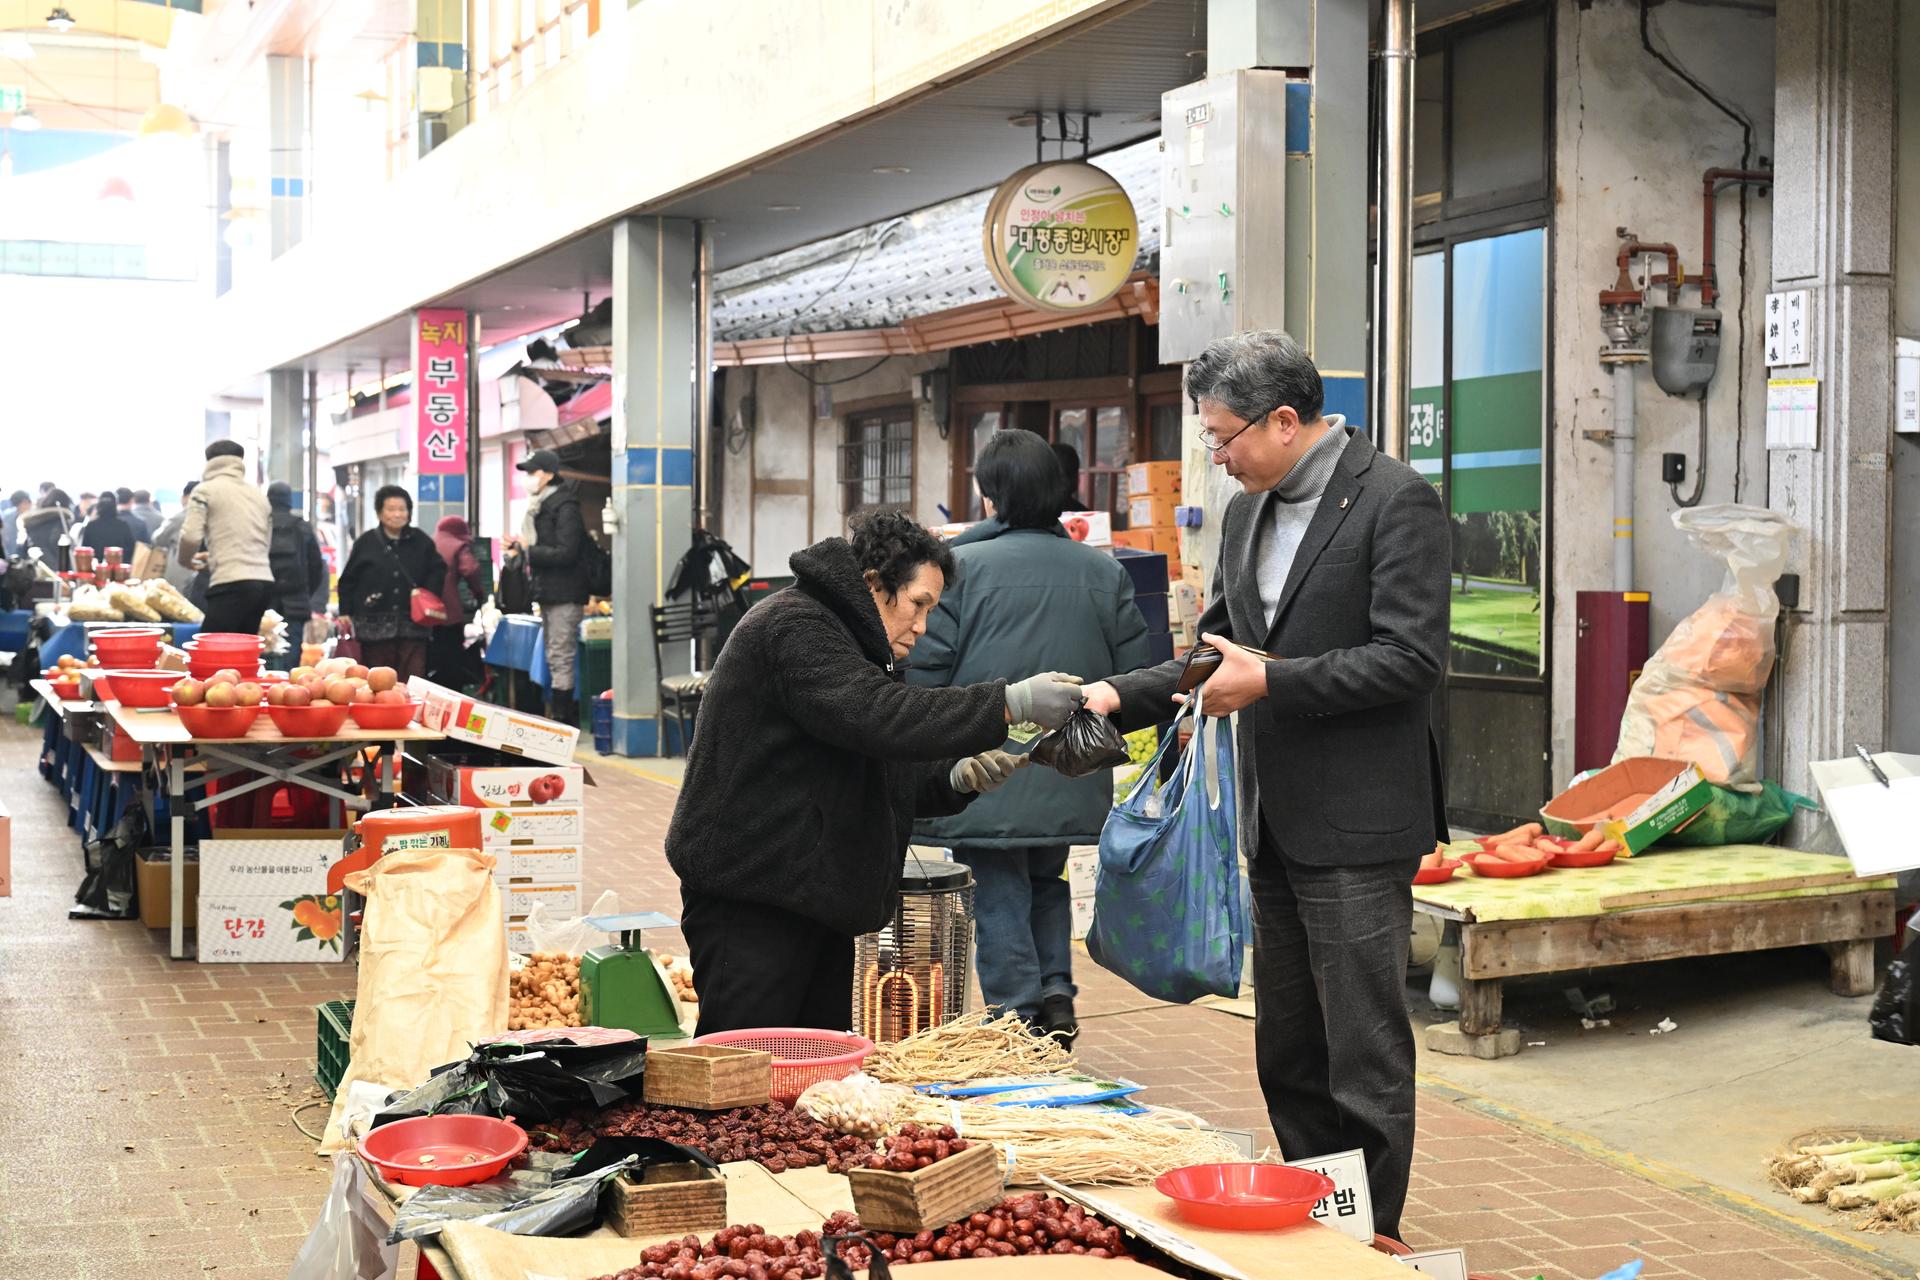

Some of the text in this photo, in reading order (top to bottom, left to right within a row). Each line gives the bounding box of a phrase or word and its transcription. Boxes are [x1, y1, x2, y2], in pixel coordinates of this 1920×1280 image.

[420, 320, 464, 346] 녹지
[426, 357, 458, 460] 부동산
[1410, 403, 1434, 448] 조경
[399, 839, 408, 849] 밤
[430, 835, 449, 848] 기계
[230, 865, 244, 874] 우리
[224, 918, 265, 939] 단감
